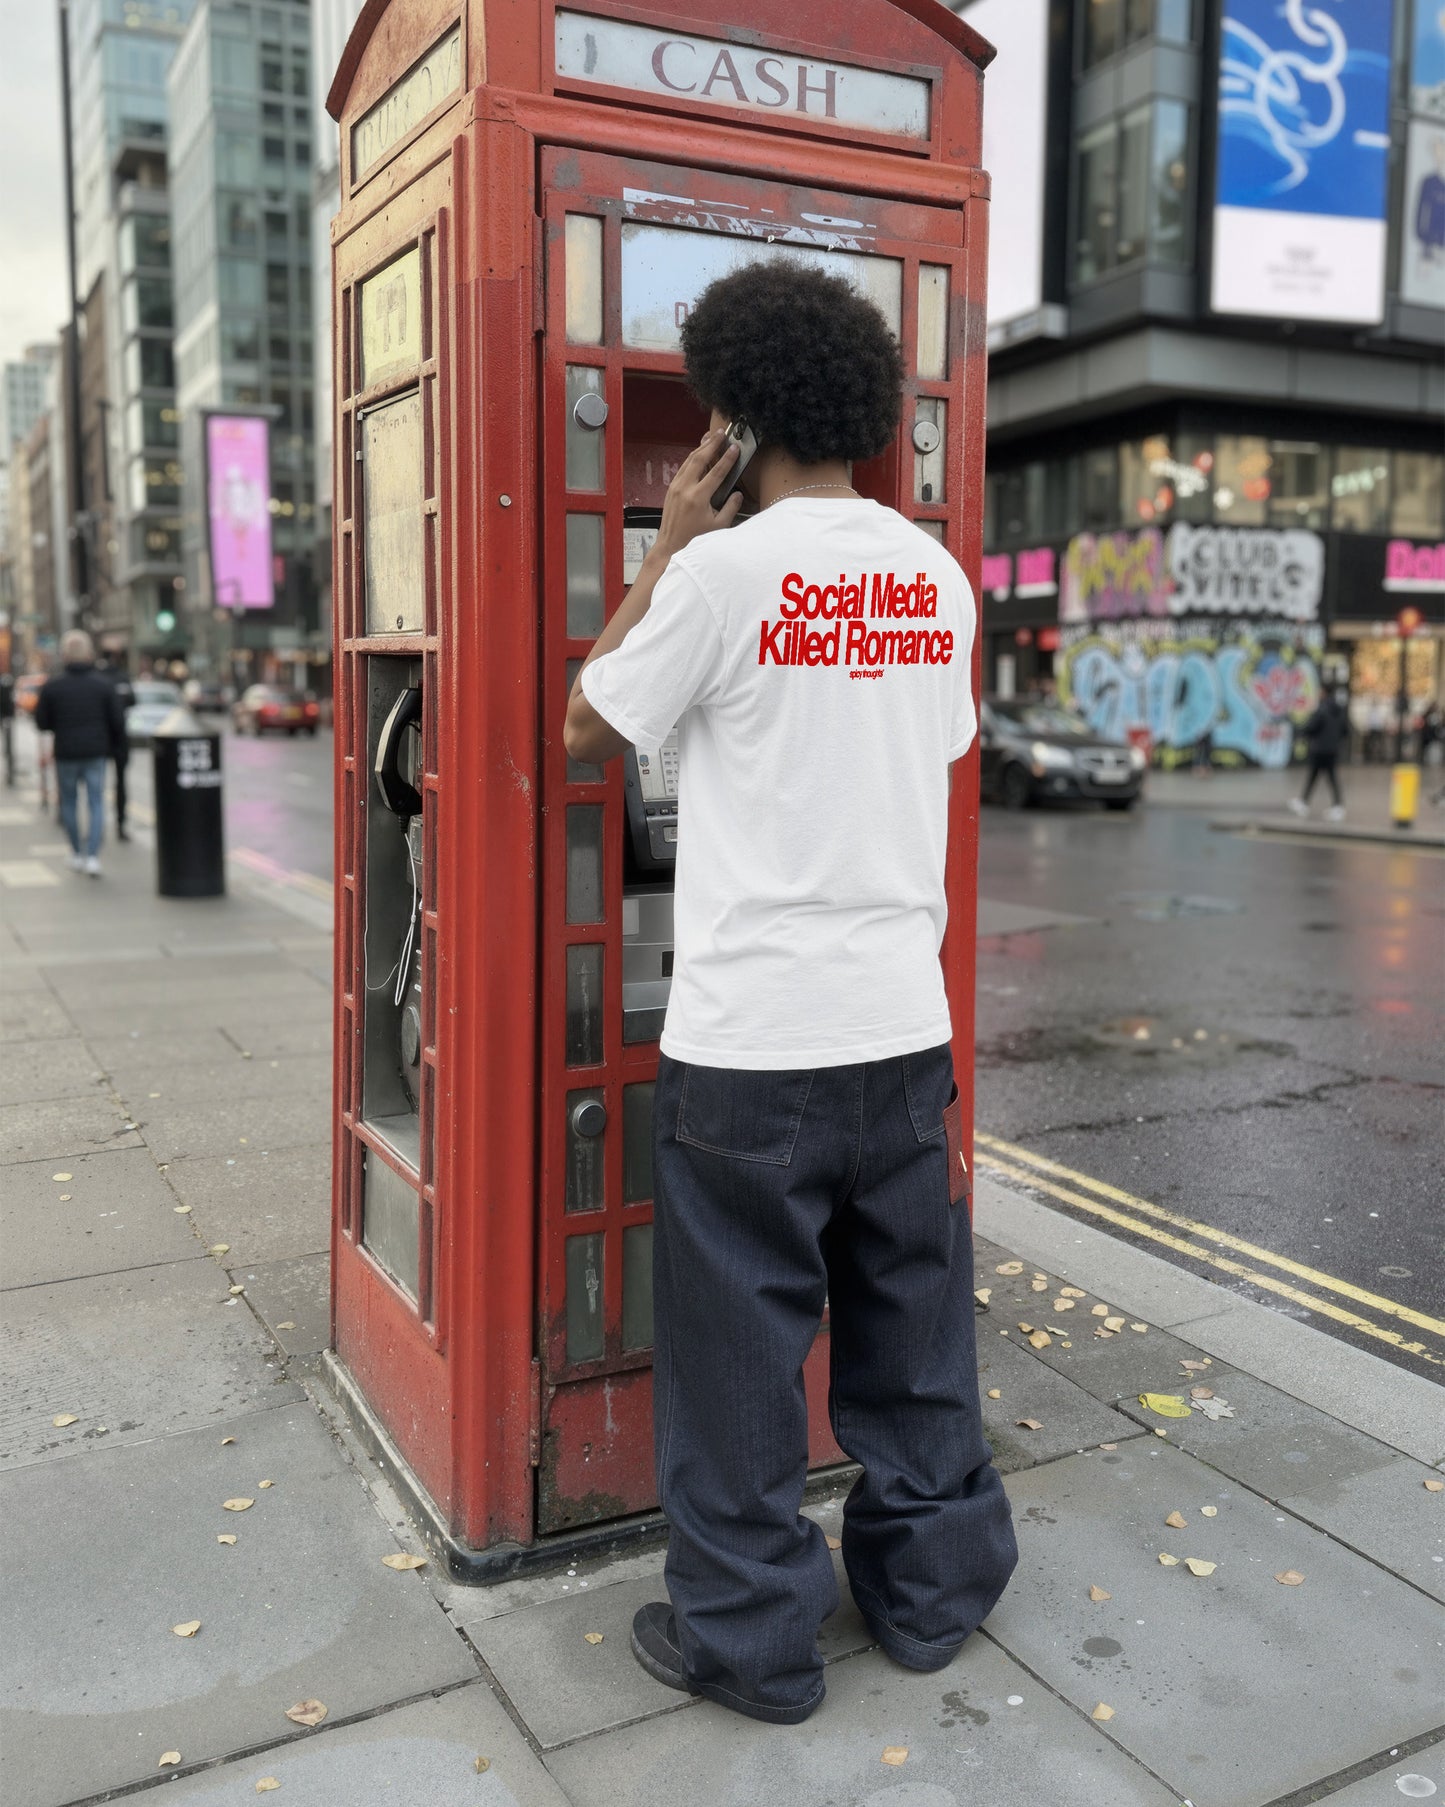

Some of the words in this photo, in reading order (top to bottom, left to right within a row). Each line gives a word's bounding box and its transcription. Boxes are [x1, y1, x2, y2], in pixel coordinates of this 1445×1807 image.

[652, 41, 837, 118] CASH
[780, 573, 867, 620] Social
[870, 573, 938, 619] Media
[758, 620, 841, 666] Killed
[845, 620, 953, 666] Romance
